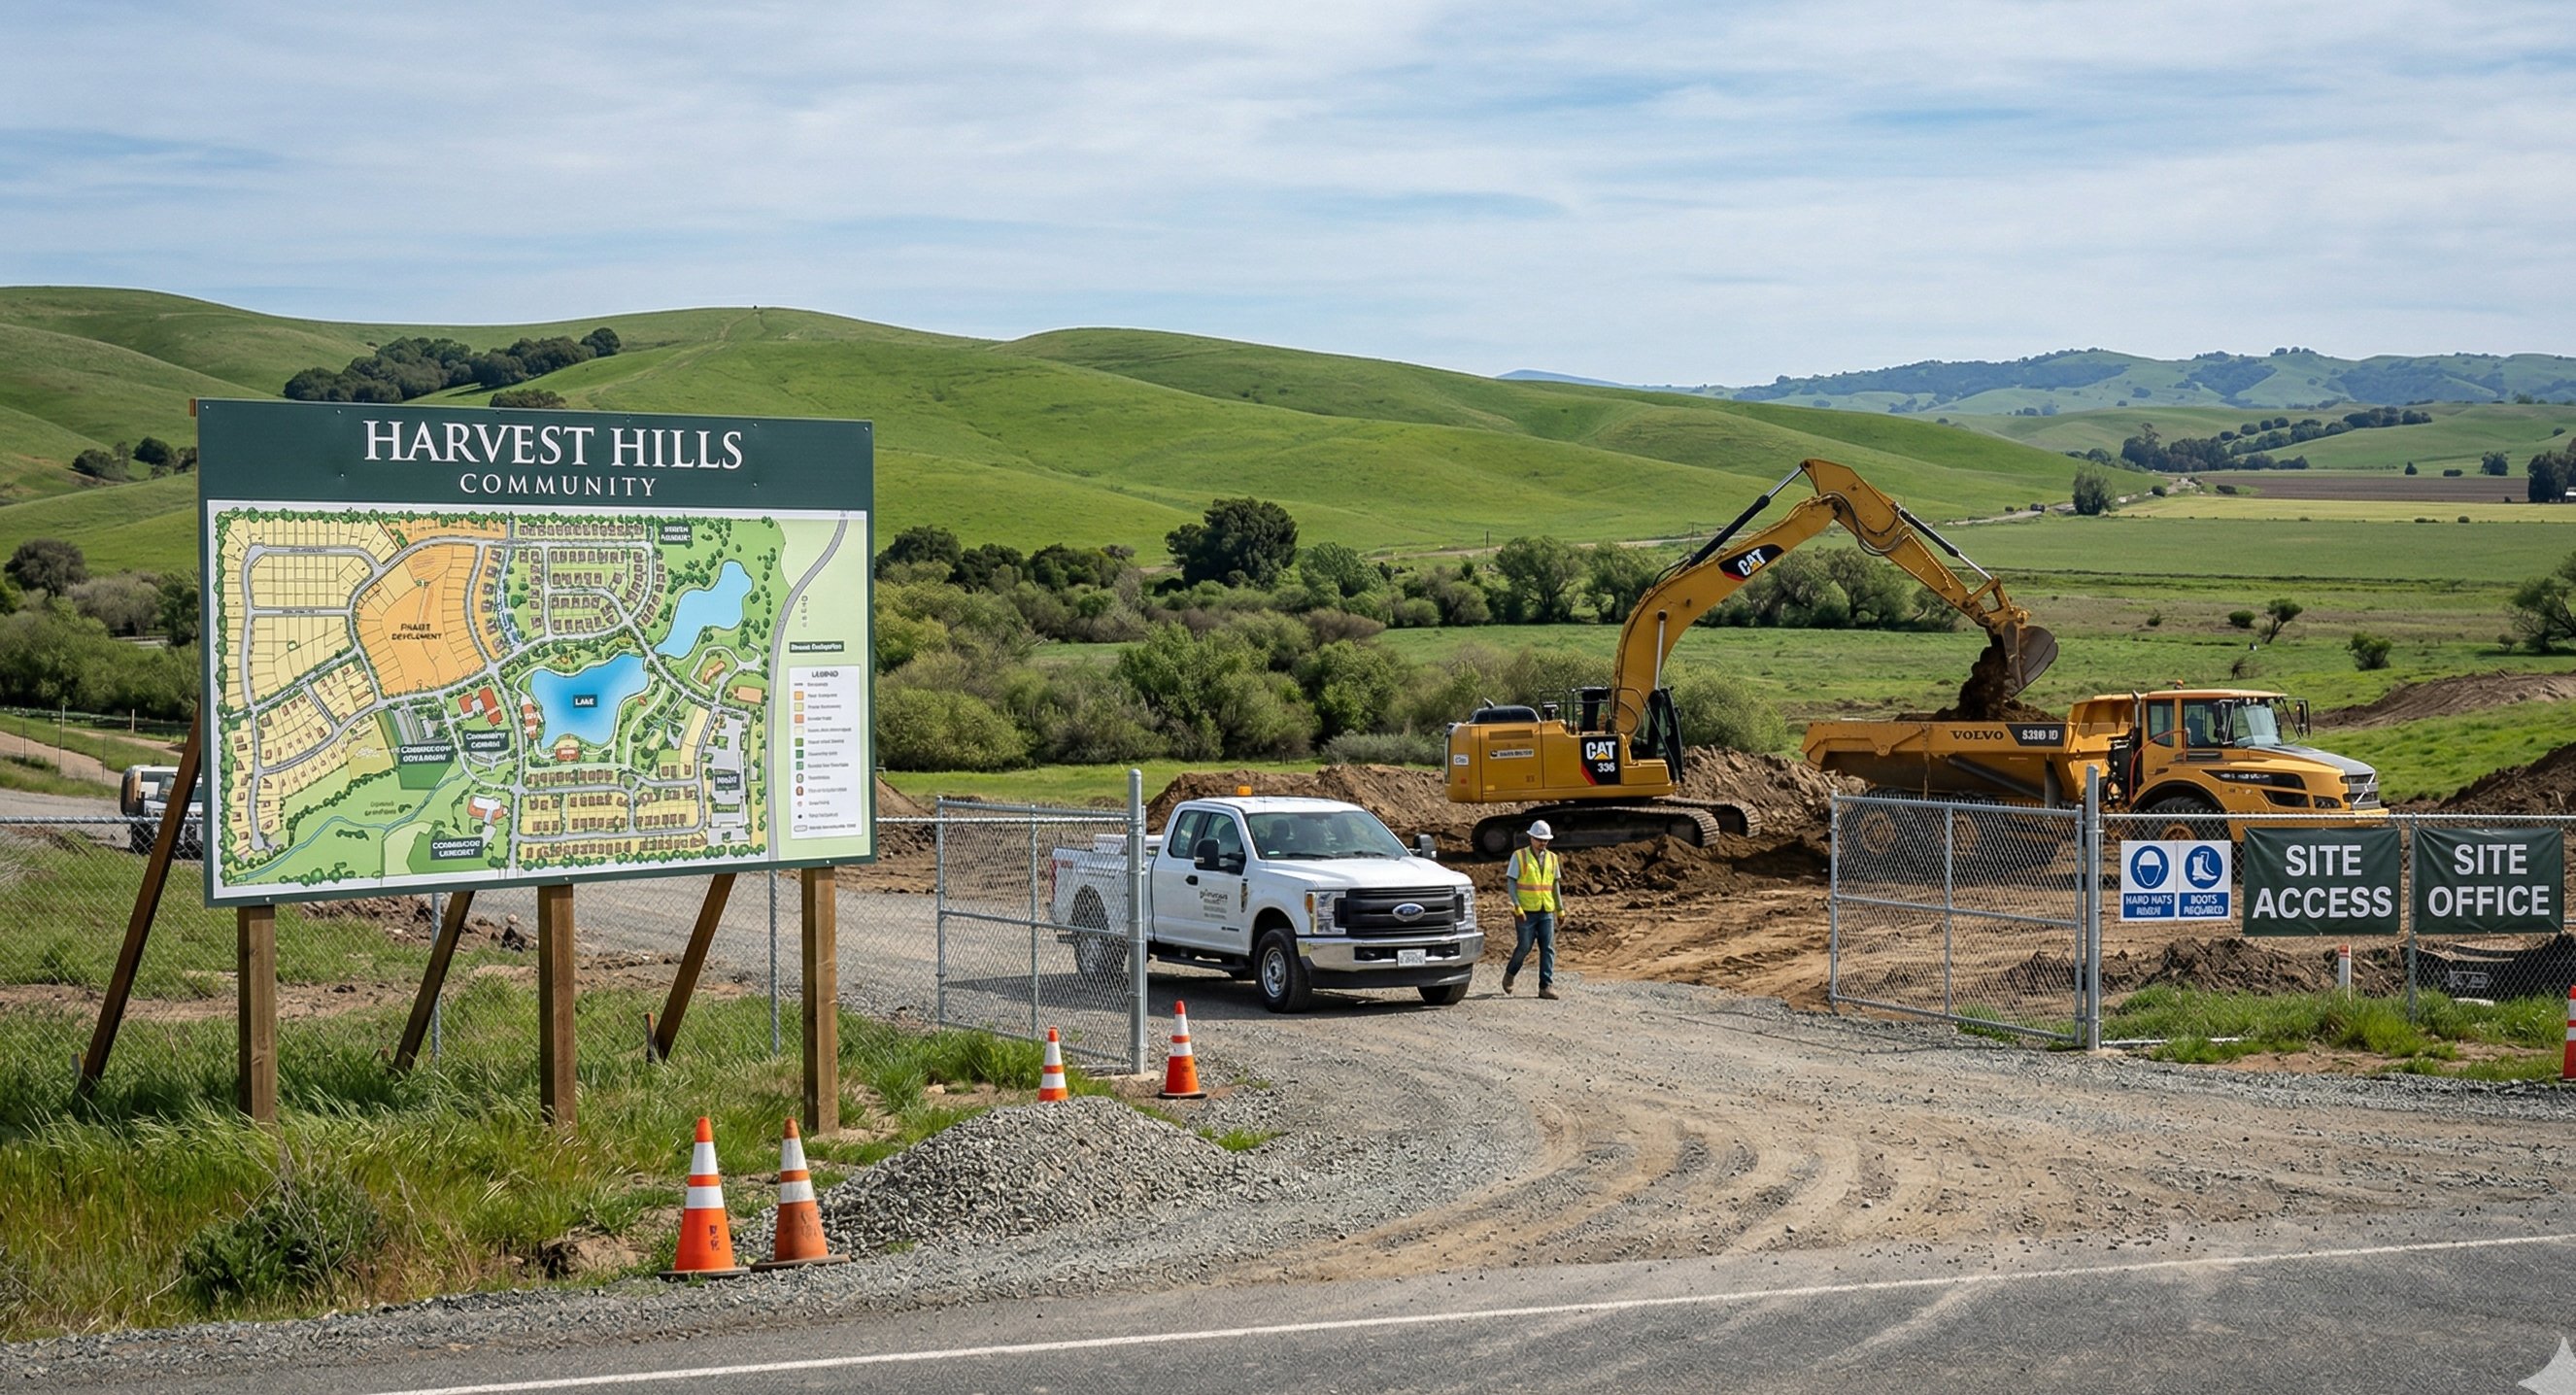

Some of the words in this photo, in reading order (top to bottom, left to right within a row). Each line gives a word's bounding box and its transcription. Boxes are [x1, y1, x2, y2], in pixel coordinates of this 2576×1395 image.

[362, 420, 594, 466] HARVEST
[609, 426, 743, 470] HILLS
[459, 473, 658, 497] COMMUNITY
[1738, 548, 1766, 576] CAT
[1949, 730, 2005, 740] VOLVO
[1585, 740, 1616, 761] CAT
[1597, 762, 1616, 773] 336
[2285, 844, 2362, 877] SITE
[2454, 843, 2527, 875] SITE
[2190, 895, 2218, 904] BOOTS
[2252, 886, 2392, 919] ACCESS
[2428, 885, 2551, 917] OFFICE
